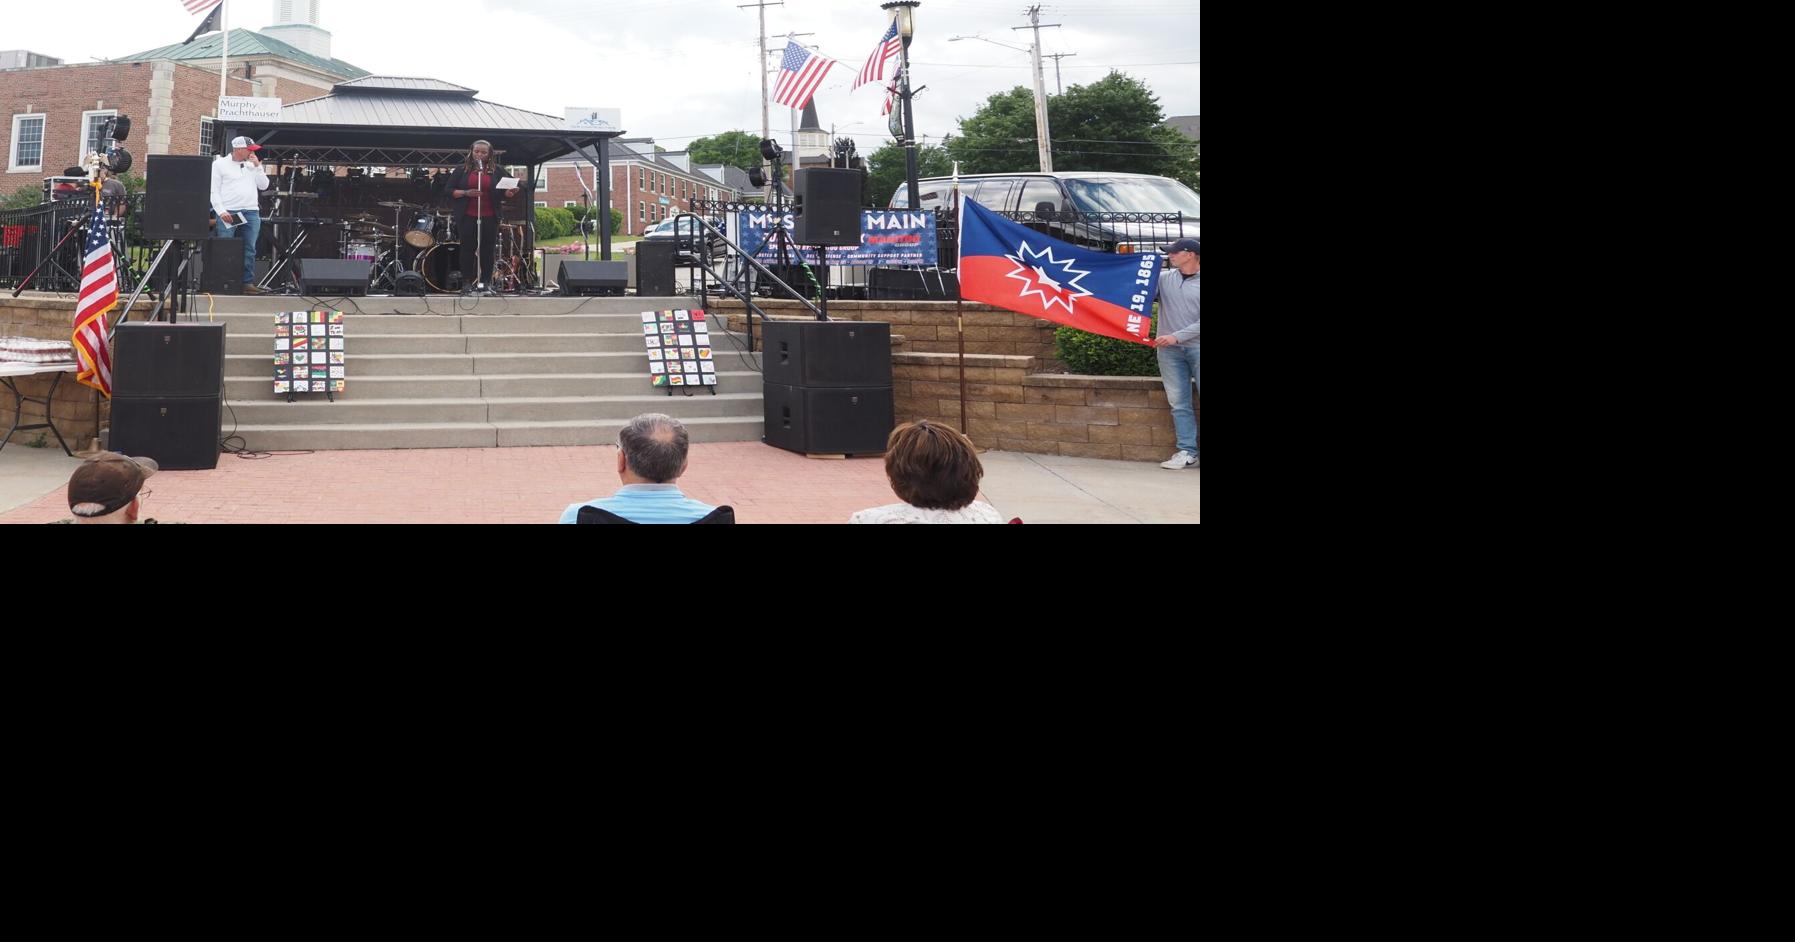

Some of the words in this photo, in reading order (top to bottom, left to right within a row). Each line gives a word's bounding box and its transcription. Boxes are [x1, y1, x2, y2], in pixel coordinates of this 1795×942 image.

[219, 108, 280, 117] Prachthauser
[220, 100, 258, 110] Murphy
[867, 213, 926, 229] MAIN
[1135, 254, 1156, 286] 1865
[1130, 290, 1148, 312] 19,
